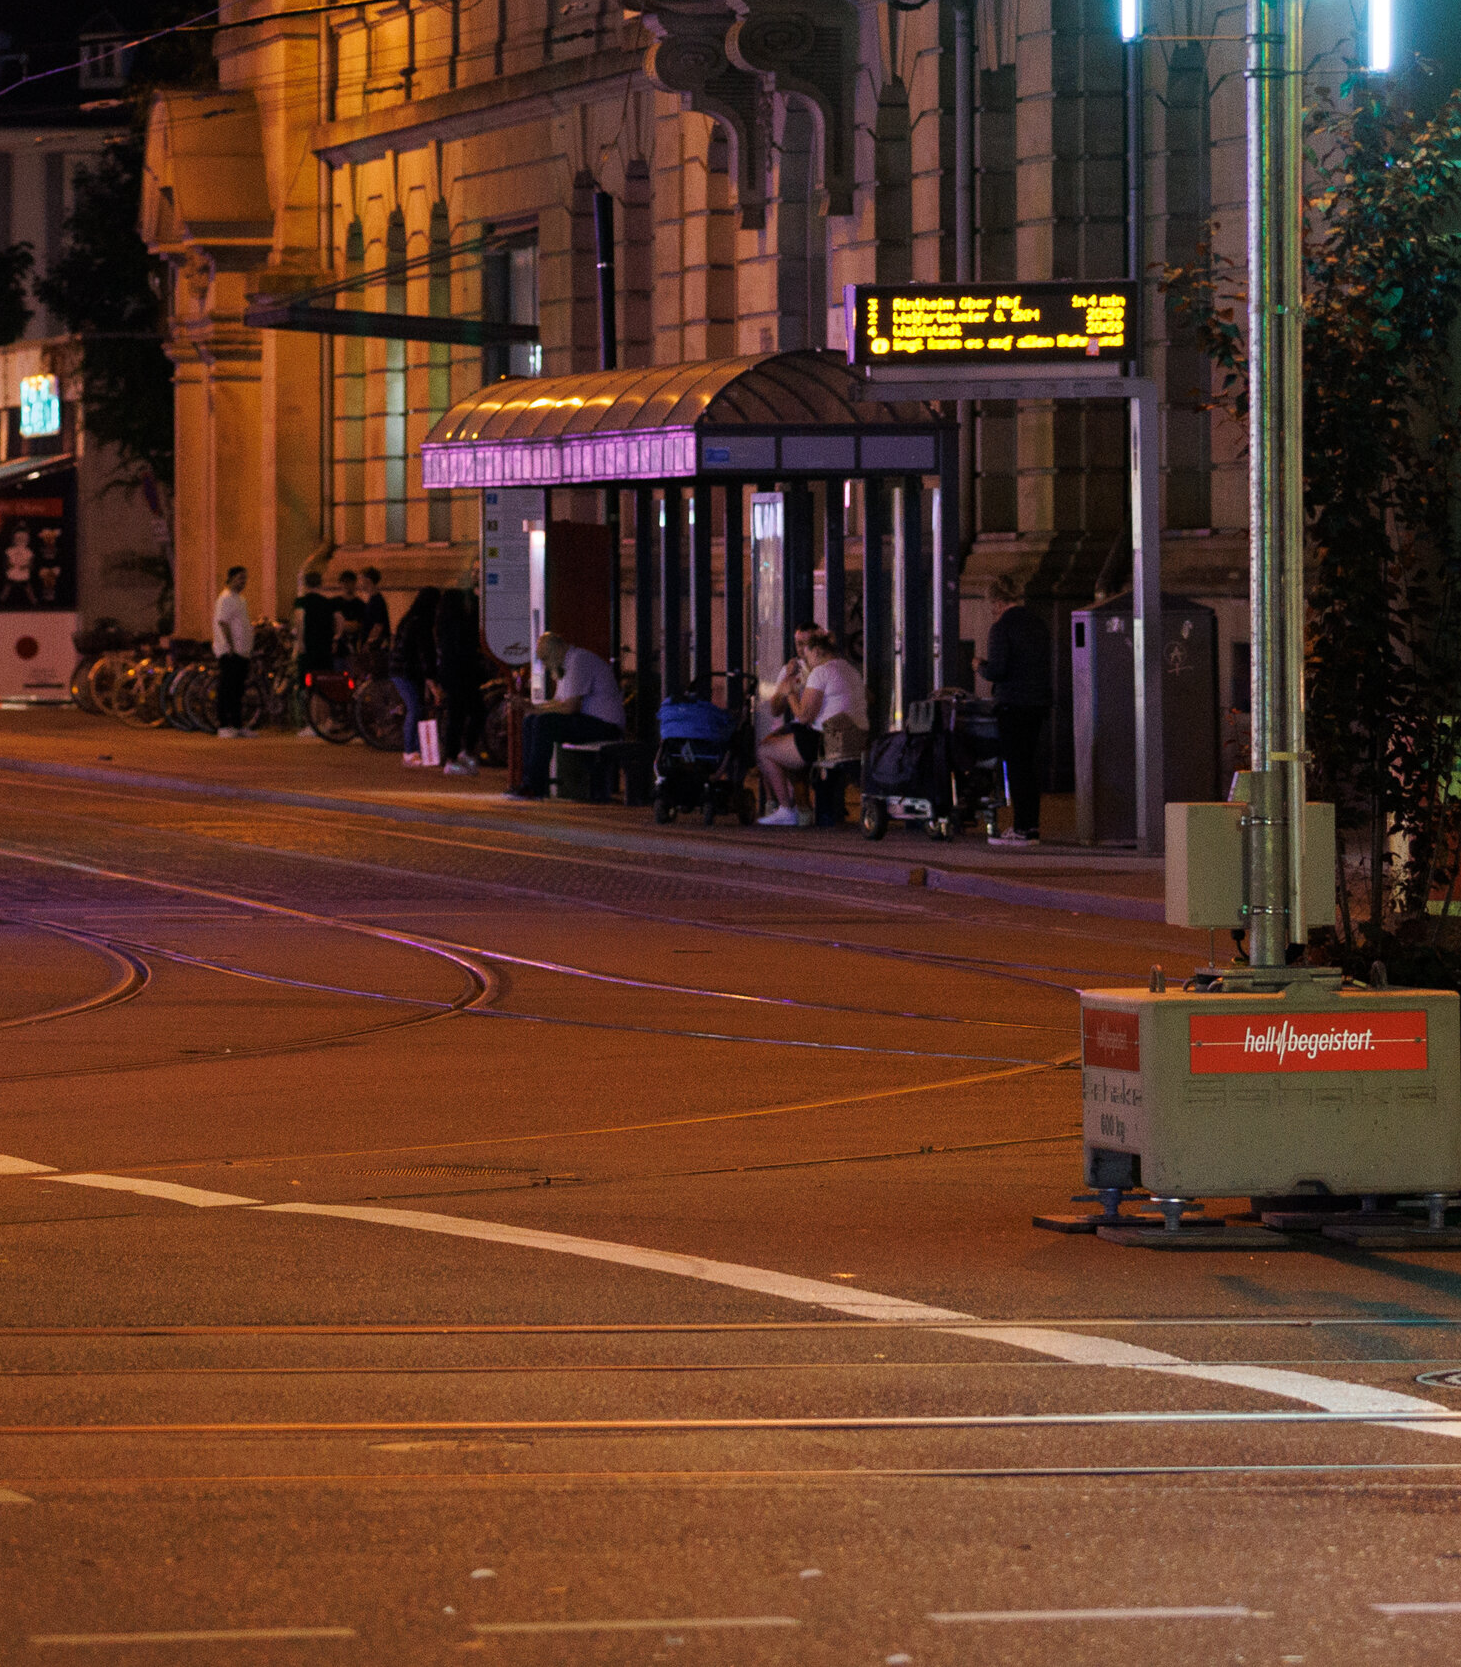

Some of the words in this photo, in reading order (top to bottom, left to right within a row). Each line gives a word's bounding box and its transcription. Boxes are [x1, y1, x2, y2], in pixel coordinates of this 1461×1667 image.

[867, 298, 878, 312] 3
[893, 297, 955, 311] Rintheim
[867, 311, 878, 325] 2
[867, 324, 878, 338] 4
[893, 323, 963, 338] Waldstadt
[1287, 1026, 1376, 1059] begeistert.
